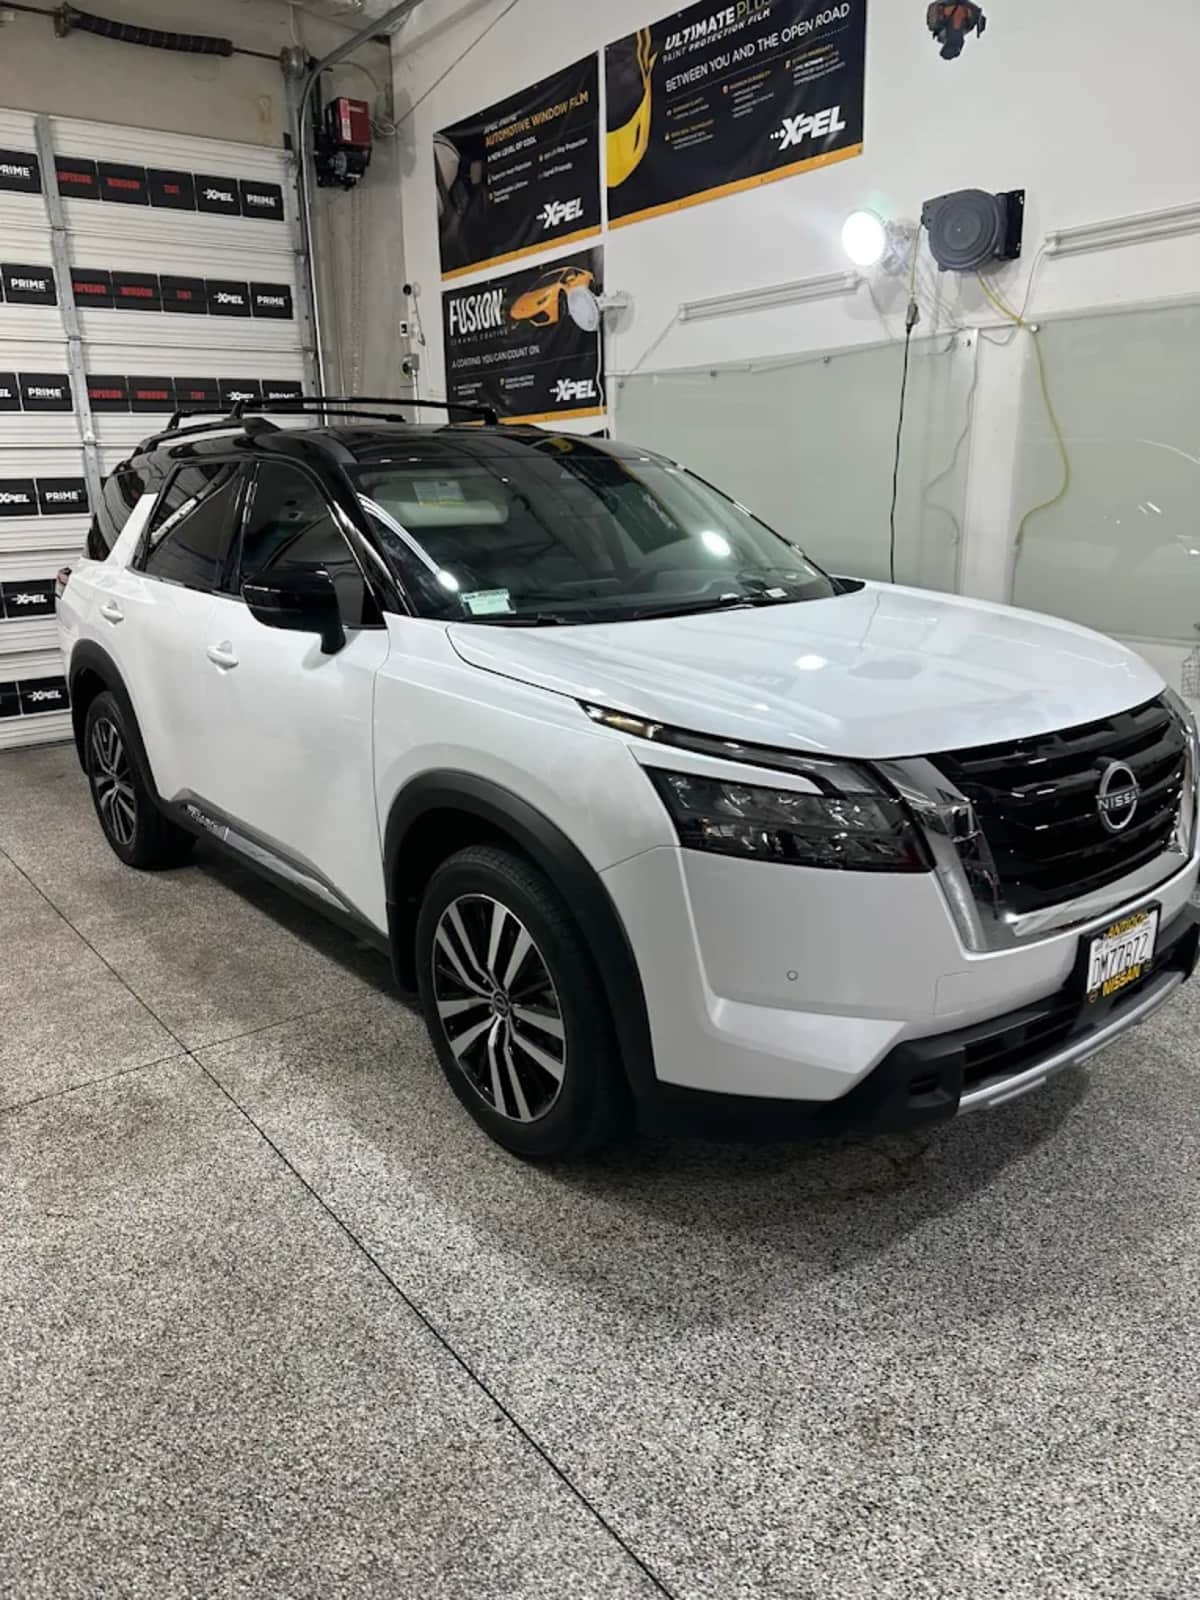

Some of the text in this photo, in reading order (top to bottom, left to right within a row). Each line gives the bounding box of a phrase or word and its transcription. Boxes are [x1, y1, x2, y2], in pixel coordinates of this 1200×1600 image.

[662, 8, 770, 64] PAINT PROTECTION FILM
[664, 6, 735, 50] ULTIMATE
[666, 66, 709, 93] BETWEEN
[709, 53, 730, 72] YOU
[732, 43, 755, 63] AND
[757, 32, 779, 52] THE
[781, 18, 813, 43] OPEN
[815, 2, 851, 27] ROAD
[486, 90, 589, 147] AUTOMOTIVE WINDOW FILM
[779, 105, 846, 151] XPEL
[0, 164, 30, 177] RIME
[207, 188, 234, 202] XPEL
[247, 193, 275, 206] PRIME
[544, 197, 583, 229] XPEL
[11, 278, 46, 289] PRIME
[218, 292, 244, 304] XPEL
[257, 295, 284, 305] PRIME
[449, 288, 503, 337] FUSION
[456, 355, 481, 368] COATING
[494, 352, 507, 362] CAN
[507, 347, 528, 360] COUNT
[28, 387, 62, 399] PRIME
[556, 377, 597, 402] XPEL
[45, 491, 79, 502] PRIME
[16, 593, 47, 605] XPEL
[32, 690, 62, 702] XPEL
[1103, 964, 1141, 997] NISSAN
